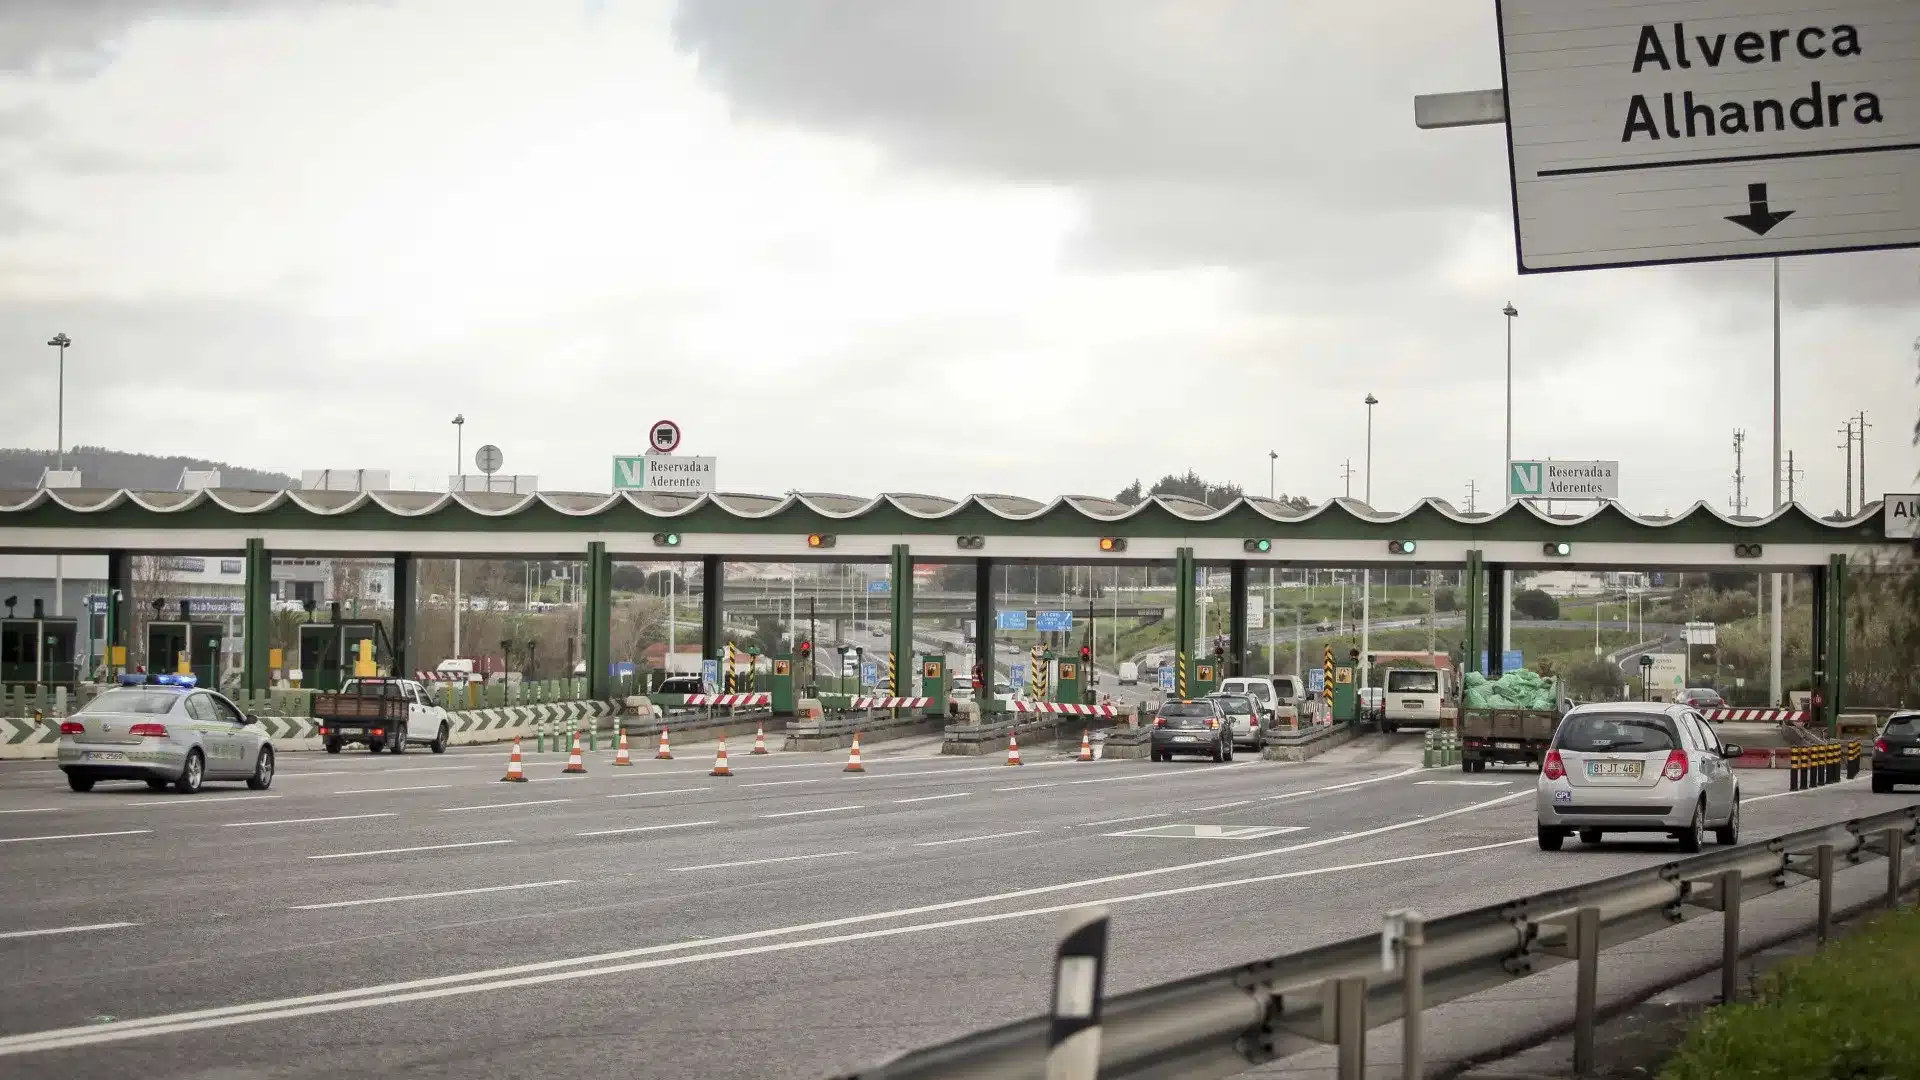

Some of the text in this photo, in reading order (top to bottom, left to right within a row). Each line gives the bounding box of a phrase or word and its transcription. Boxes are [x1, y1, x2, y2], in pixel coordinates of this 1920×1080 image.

[1632, 22, 1862, 74] Alverca
[1621, 80, 1884, 142] Alhandra
[650, 460, 700, 471] Reservada
[1549, 465, 1611, 477] Reservada a
[650, 476, 701, 487] Aderentes
[1549, 481, 1603, 492] Aderentes
[1893, 501, 1920, 518] Al
[1555, 791, 1571, 799] GPL
